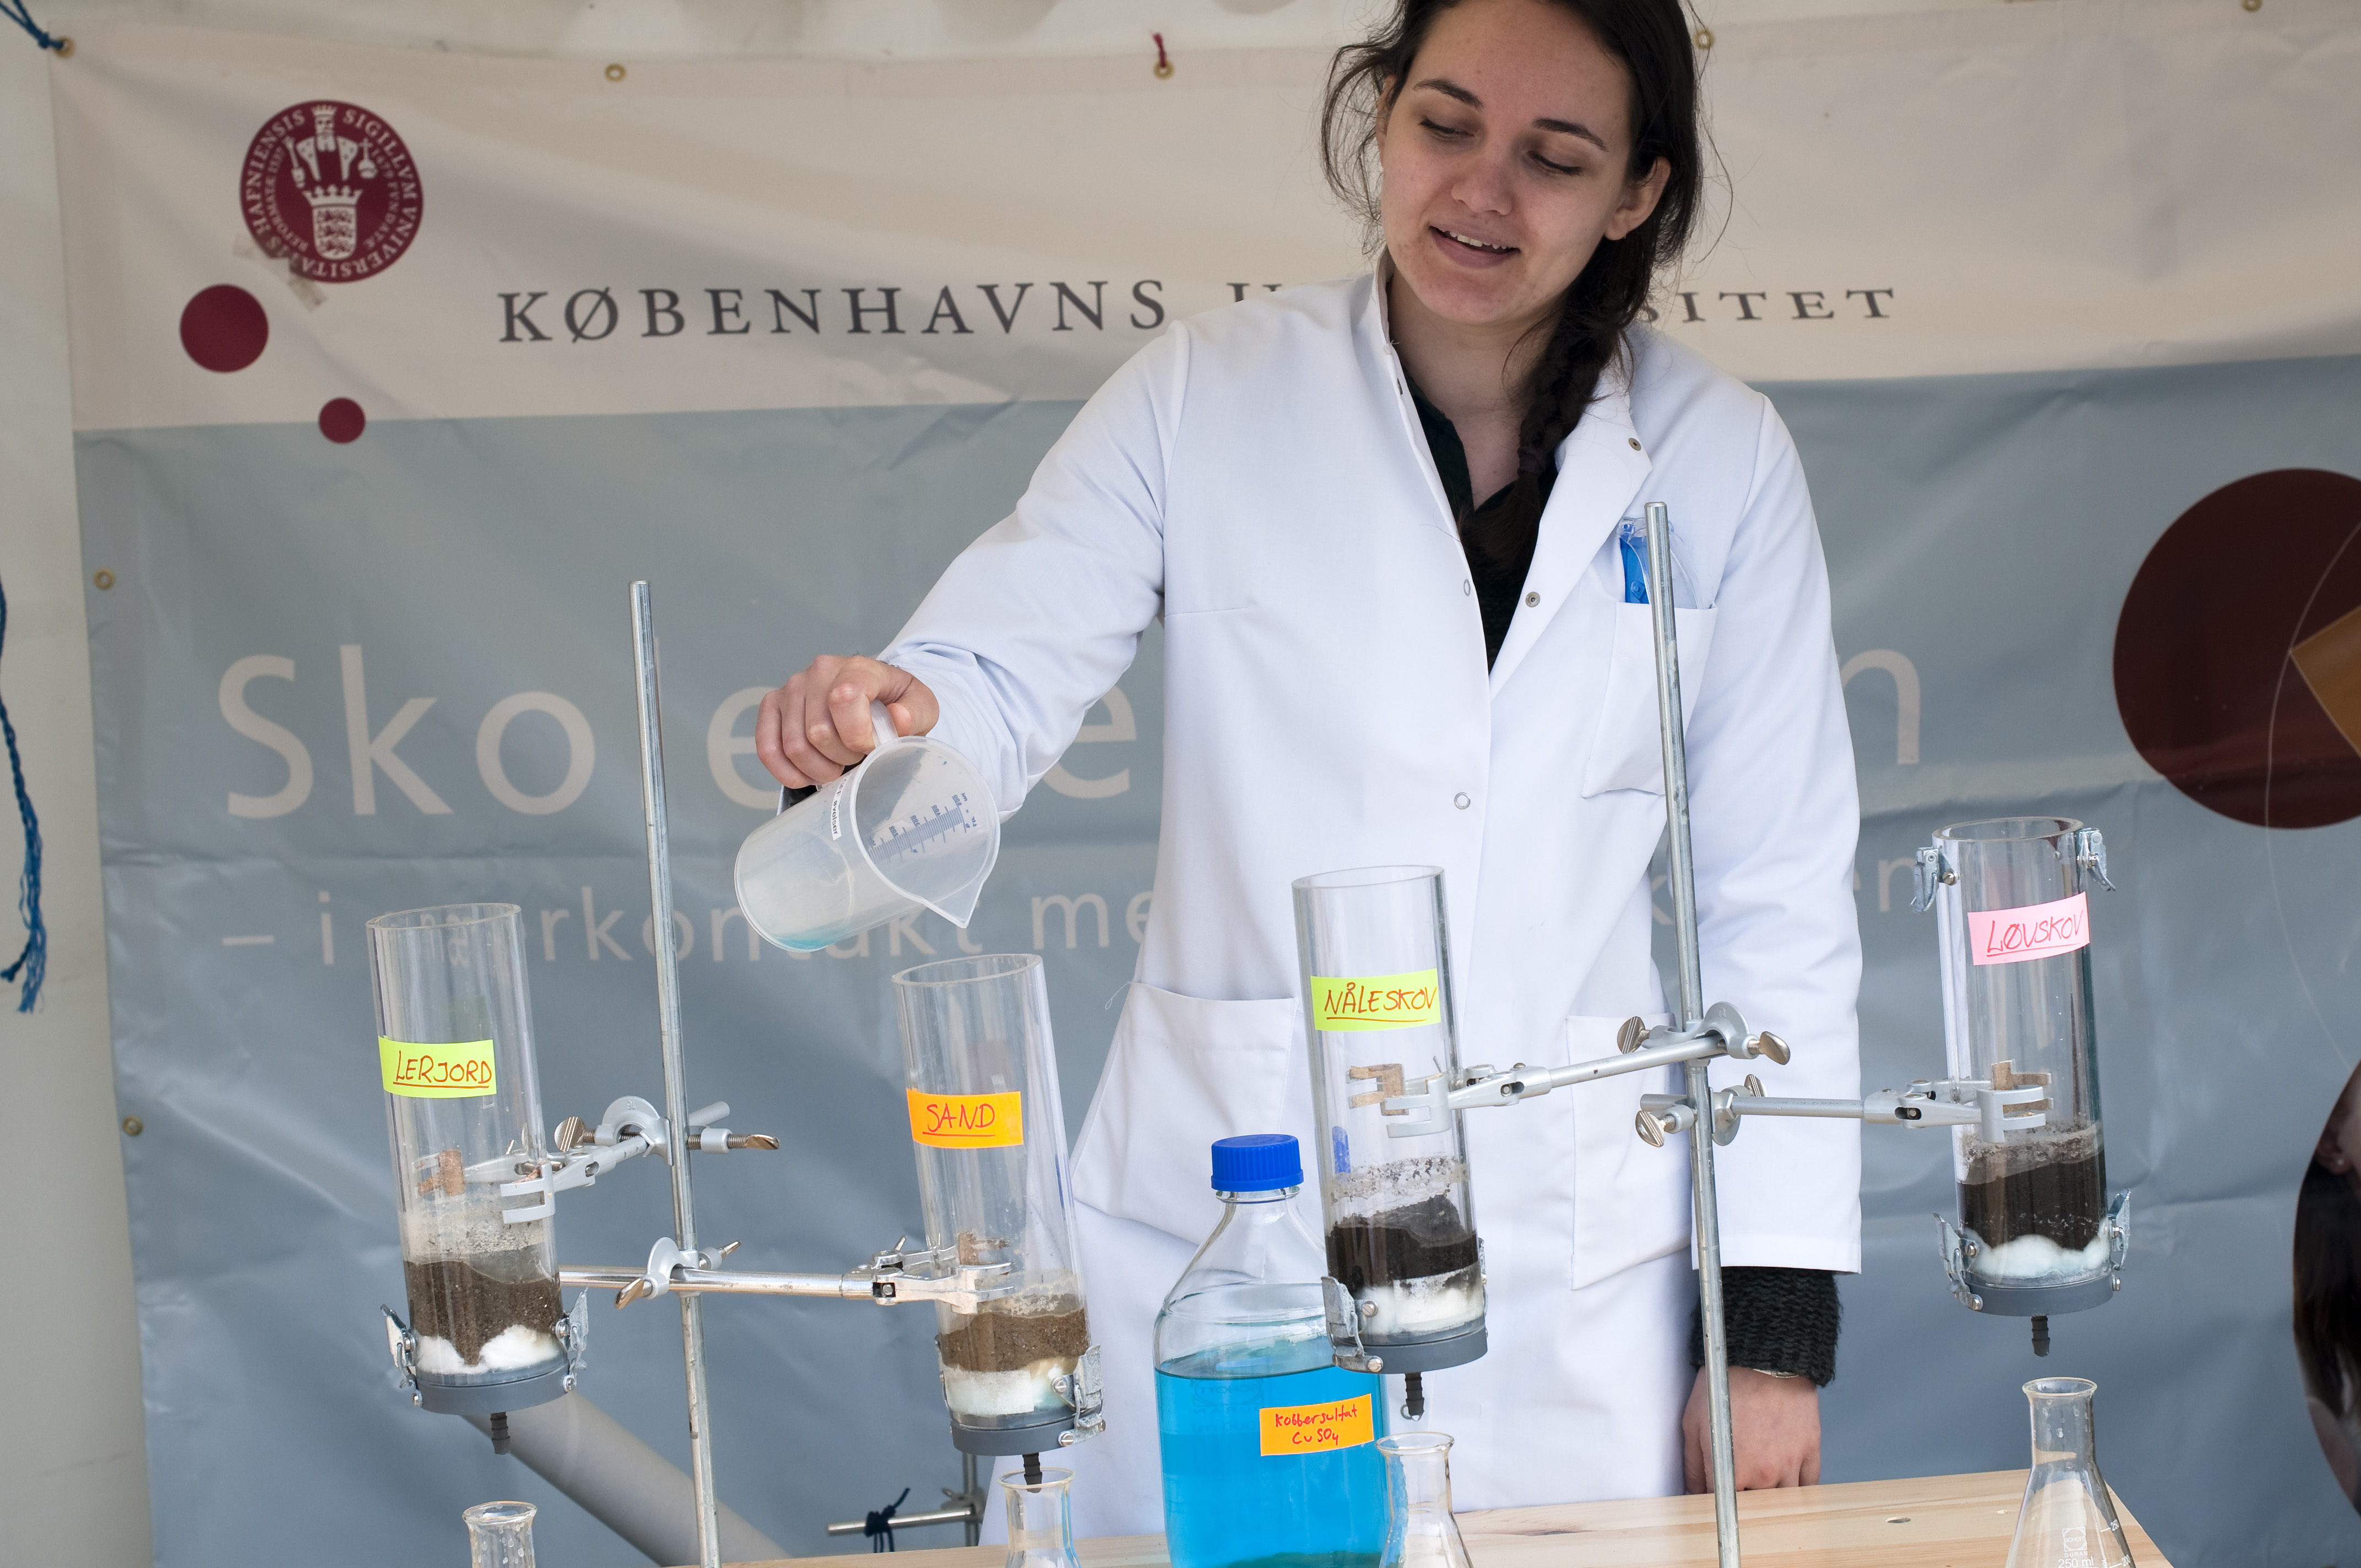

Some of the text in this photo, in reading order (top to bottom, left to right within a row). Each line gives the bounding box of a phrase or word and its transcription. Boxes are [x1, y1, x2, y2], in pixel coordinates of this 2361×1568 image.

[246, 110, 305, 235] HAFNIENSIS
[342, 109, 417, 199] SIGILLVM
[496, 279, 1166, 345] KØBENHAVNS
[1031, 890, 1154, 950] me
[1987, 910, 2084, 954] LØVSKOV
[1324, 982, 1438, 1015] NÅLESKOV
[395, 1050, 492, 1084] LERJORD
[926, 1103, 995, 1133] SAND
[2058, 1558, 2079, 1568] 250
[2081, 1556, 2094, 1567] ml
